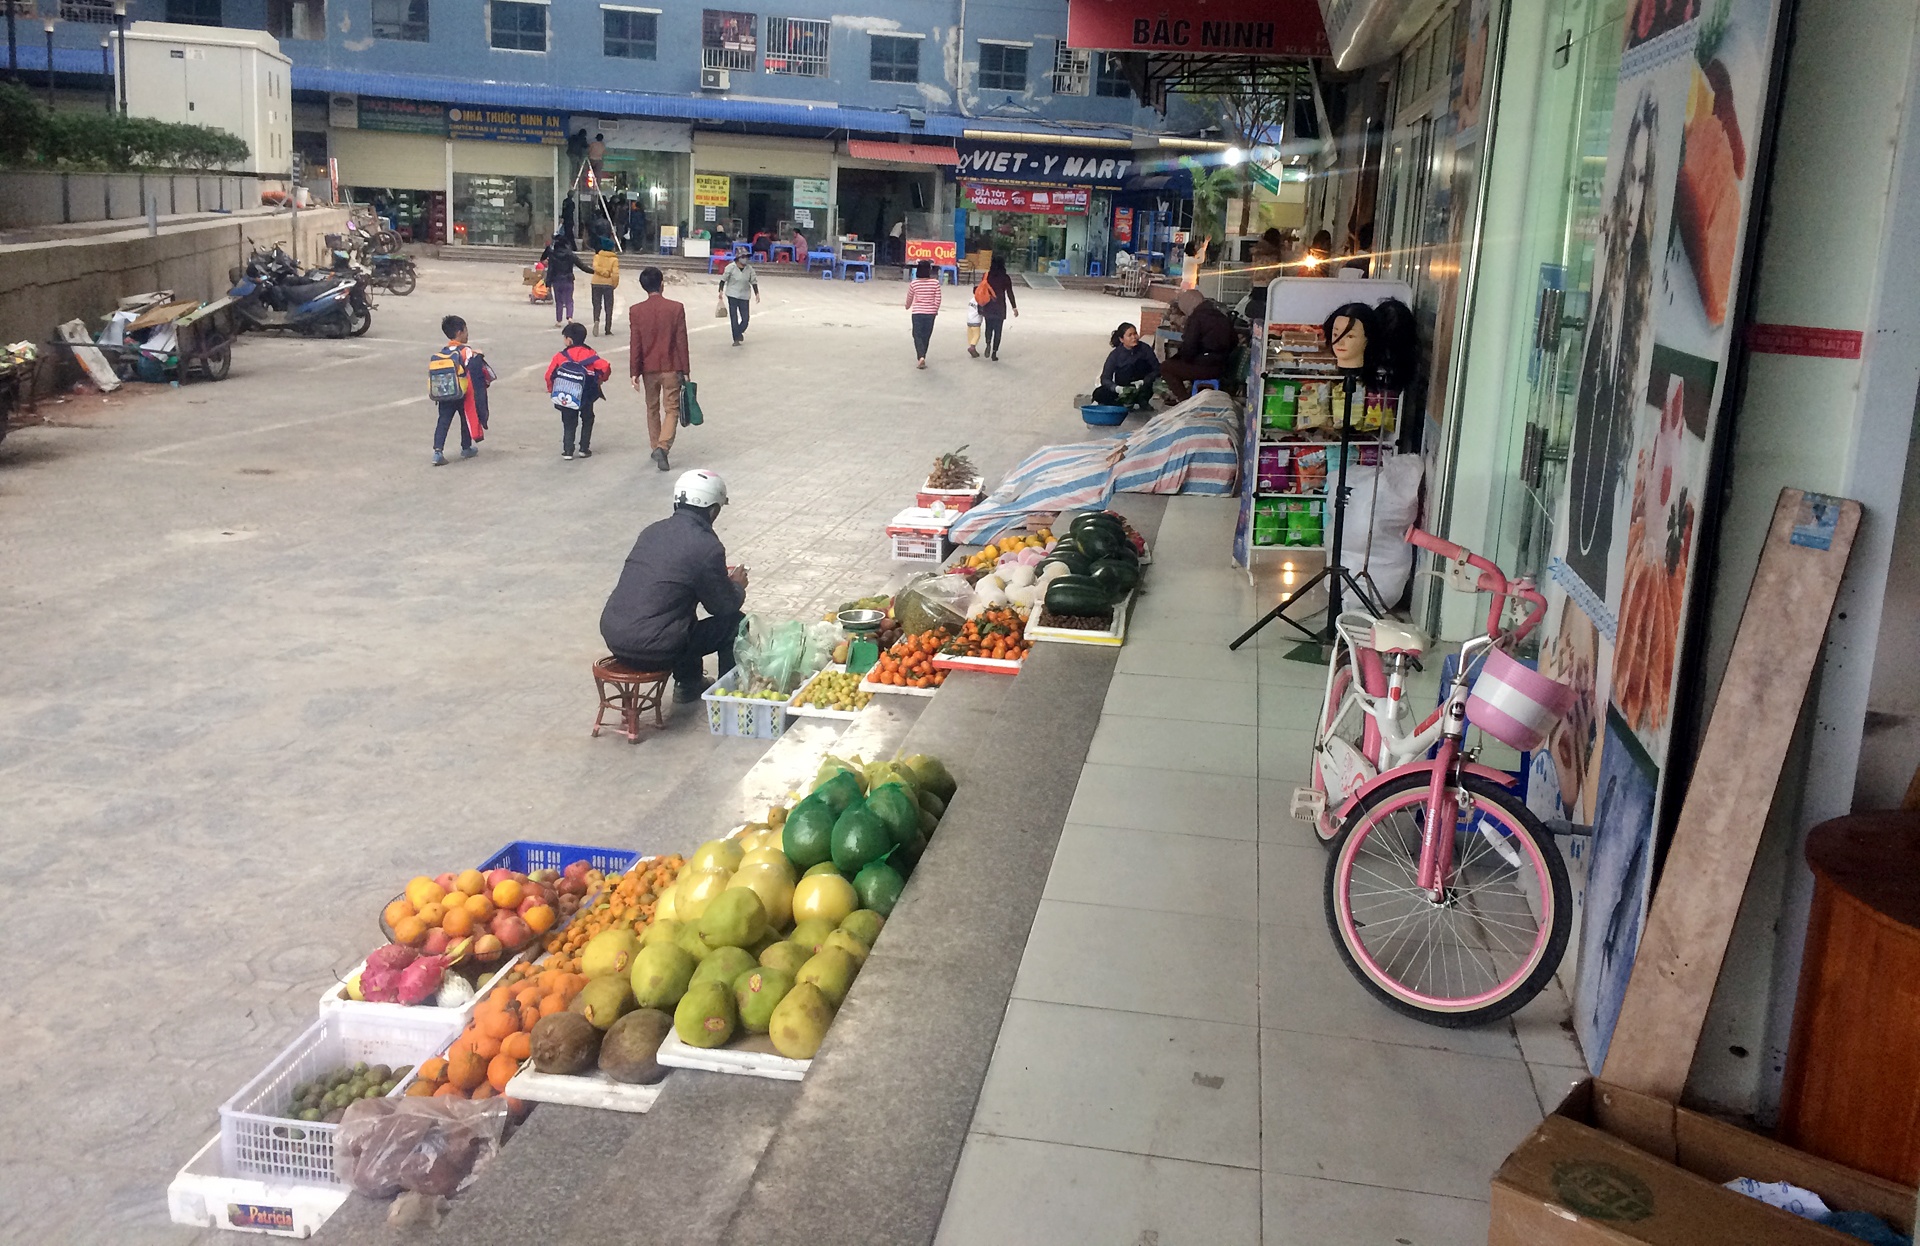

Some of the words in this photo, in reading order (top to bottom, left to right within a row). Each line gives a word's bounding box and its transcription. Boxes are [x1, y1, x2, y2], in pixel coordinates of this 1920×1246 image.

[1133, 10, 1191, 46] BẮC
[1201, 20, 1275, 49] NINH
[972, 150, 1029, 173] VIET
[1043, 155, 1059, 175] Y
[1062, 157, 1132, 181] MART
[907, 245, 932, 257] Cơm
[934, 246, 956, 259] Quê
[249, 1206, 293, 1226] Patricia
